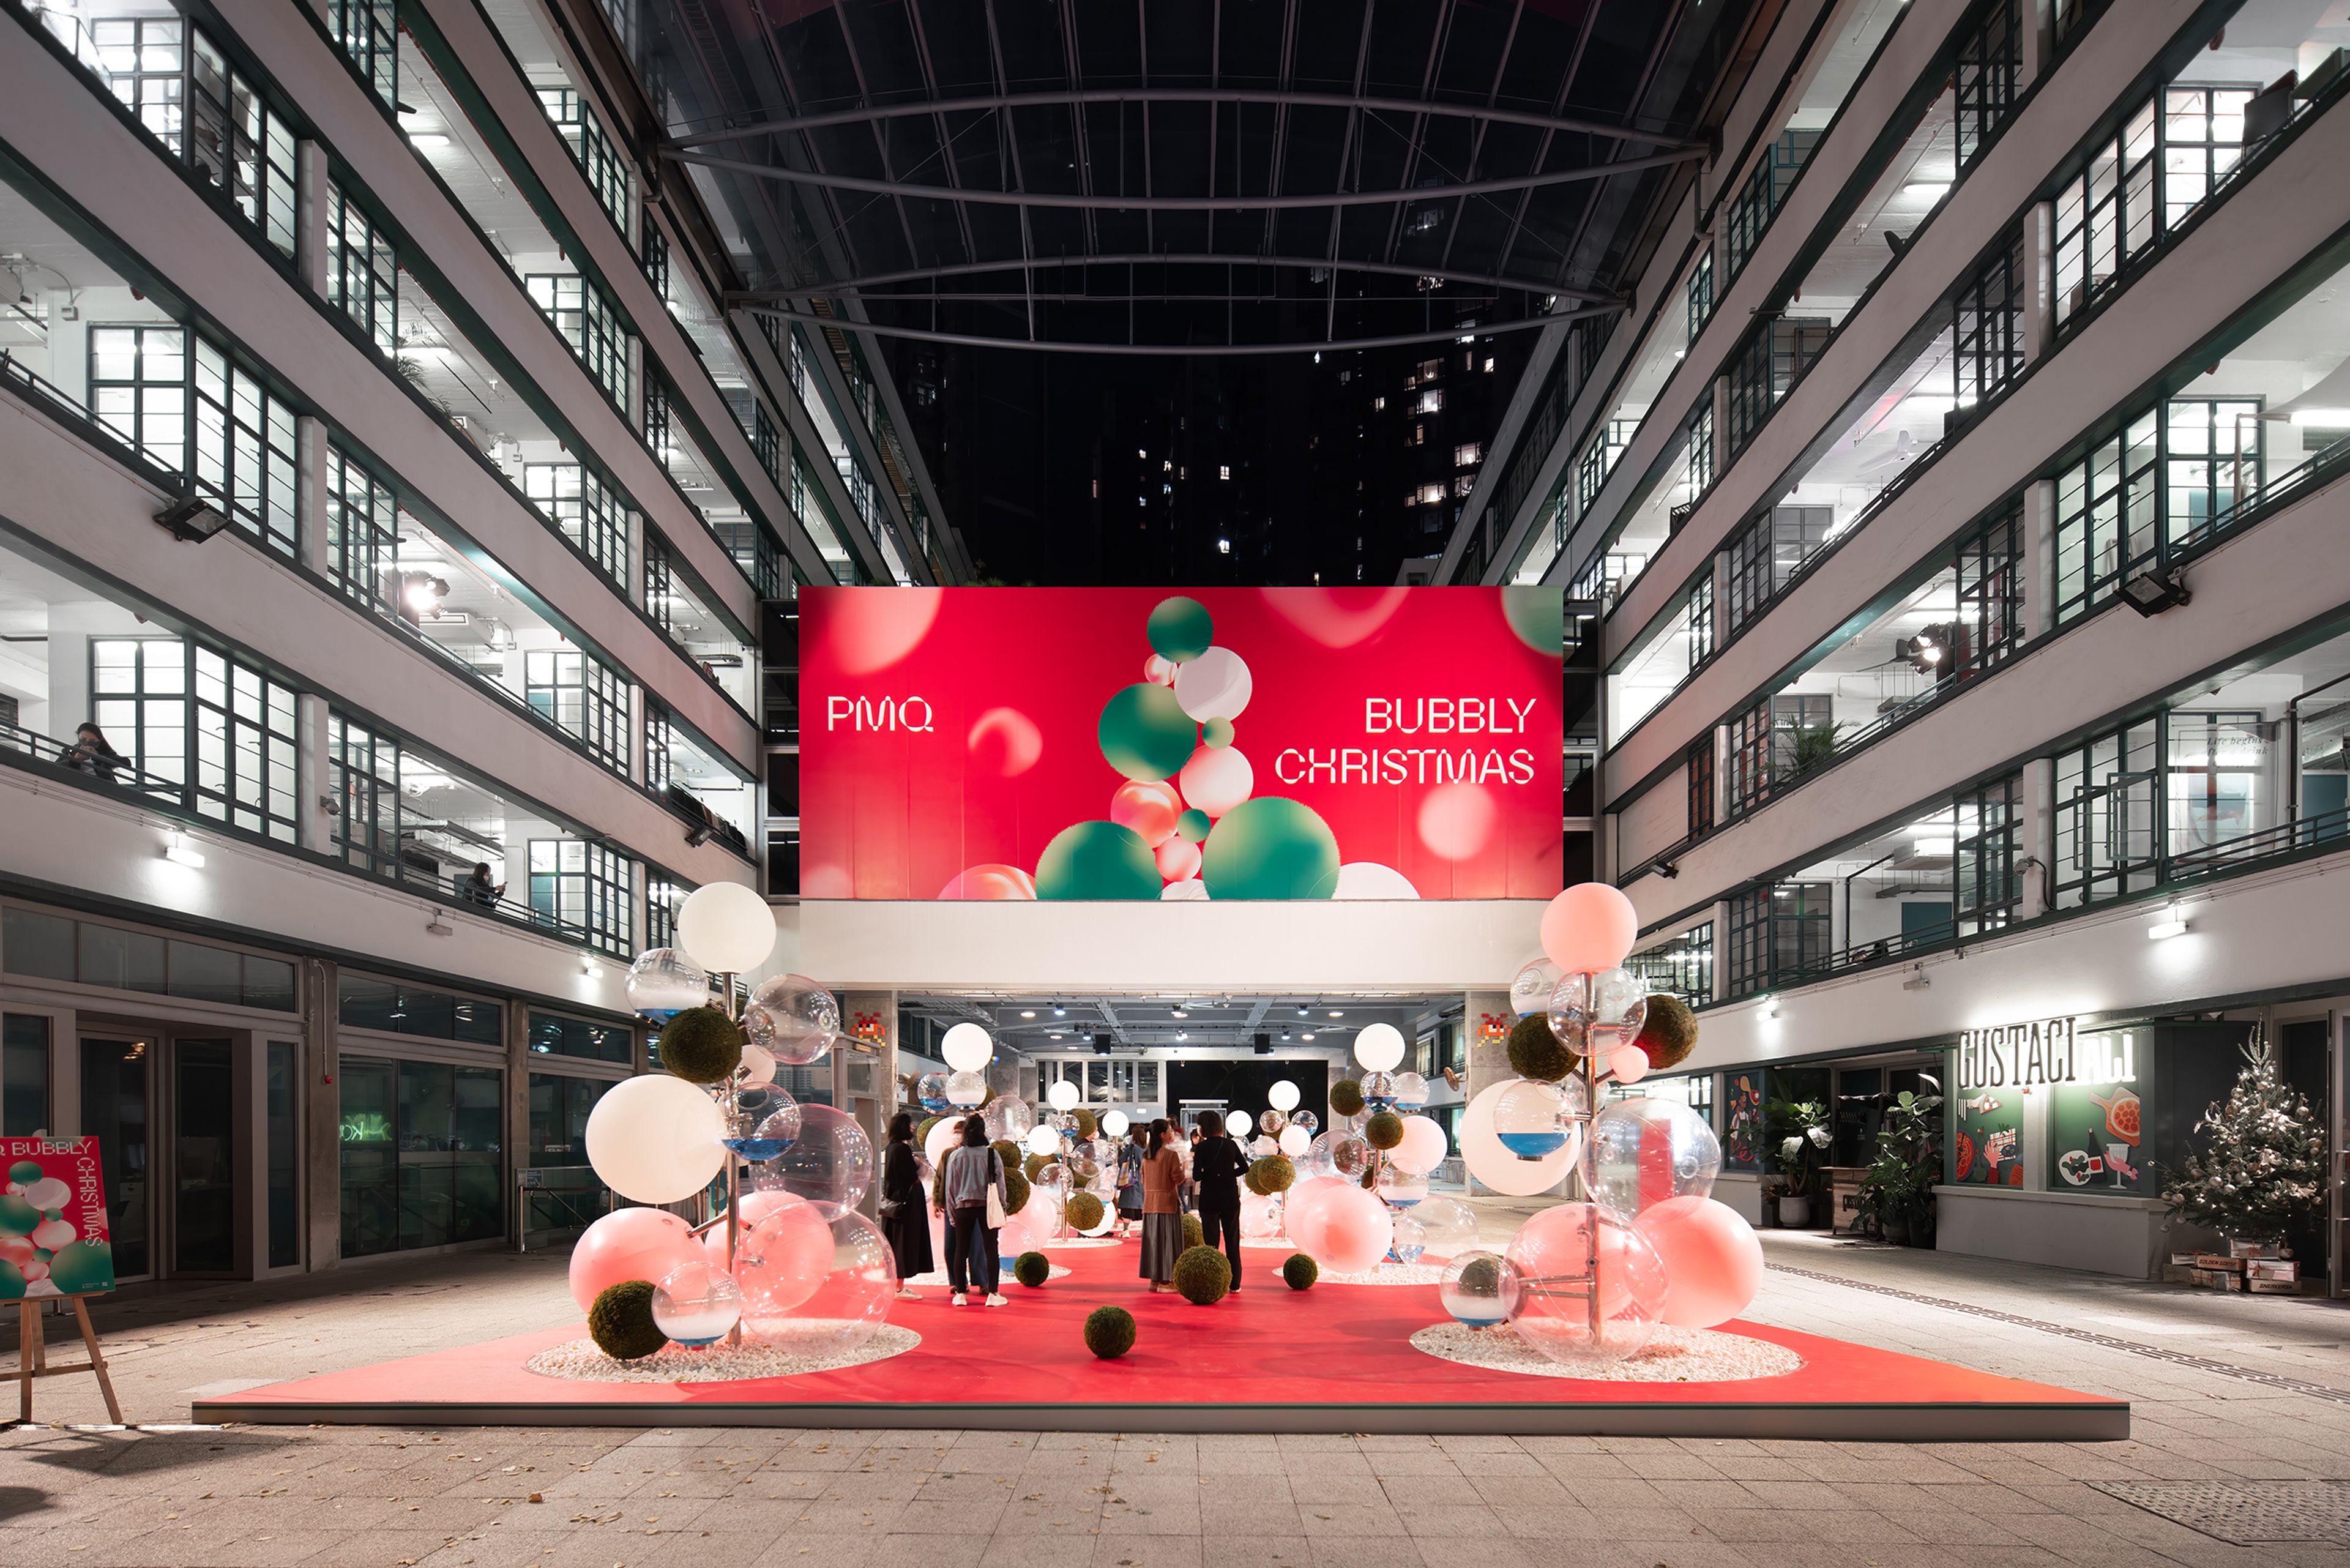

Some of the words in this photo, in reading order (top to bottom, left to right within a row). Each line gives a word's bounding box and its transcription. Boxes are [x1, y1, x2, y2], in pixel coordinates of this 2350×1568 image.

[828, 695, 934, 732] PMQ
[1366, 698, 1537, 733] BUBBLY
[2230, 737, 2262, 745] begins
[1275, 749, 1534, 785] CHRISTMAS
[1958, 1017, 2076, 1089] GUSTACI
[12, 1141, 92, 1155] BUBBLY
[77, 1157, 103, 1247] CHRISTMAS
